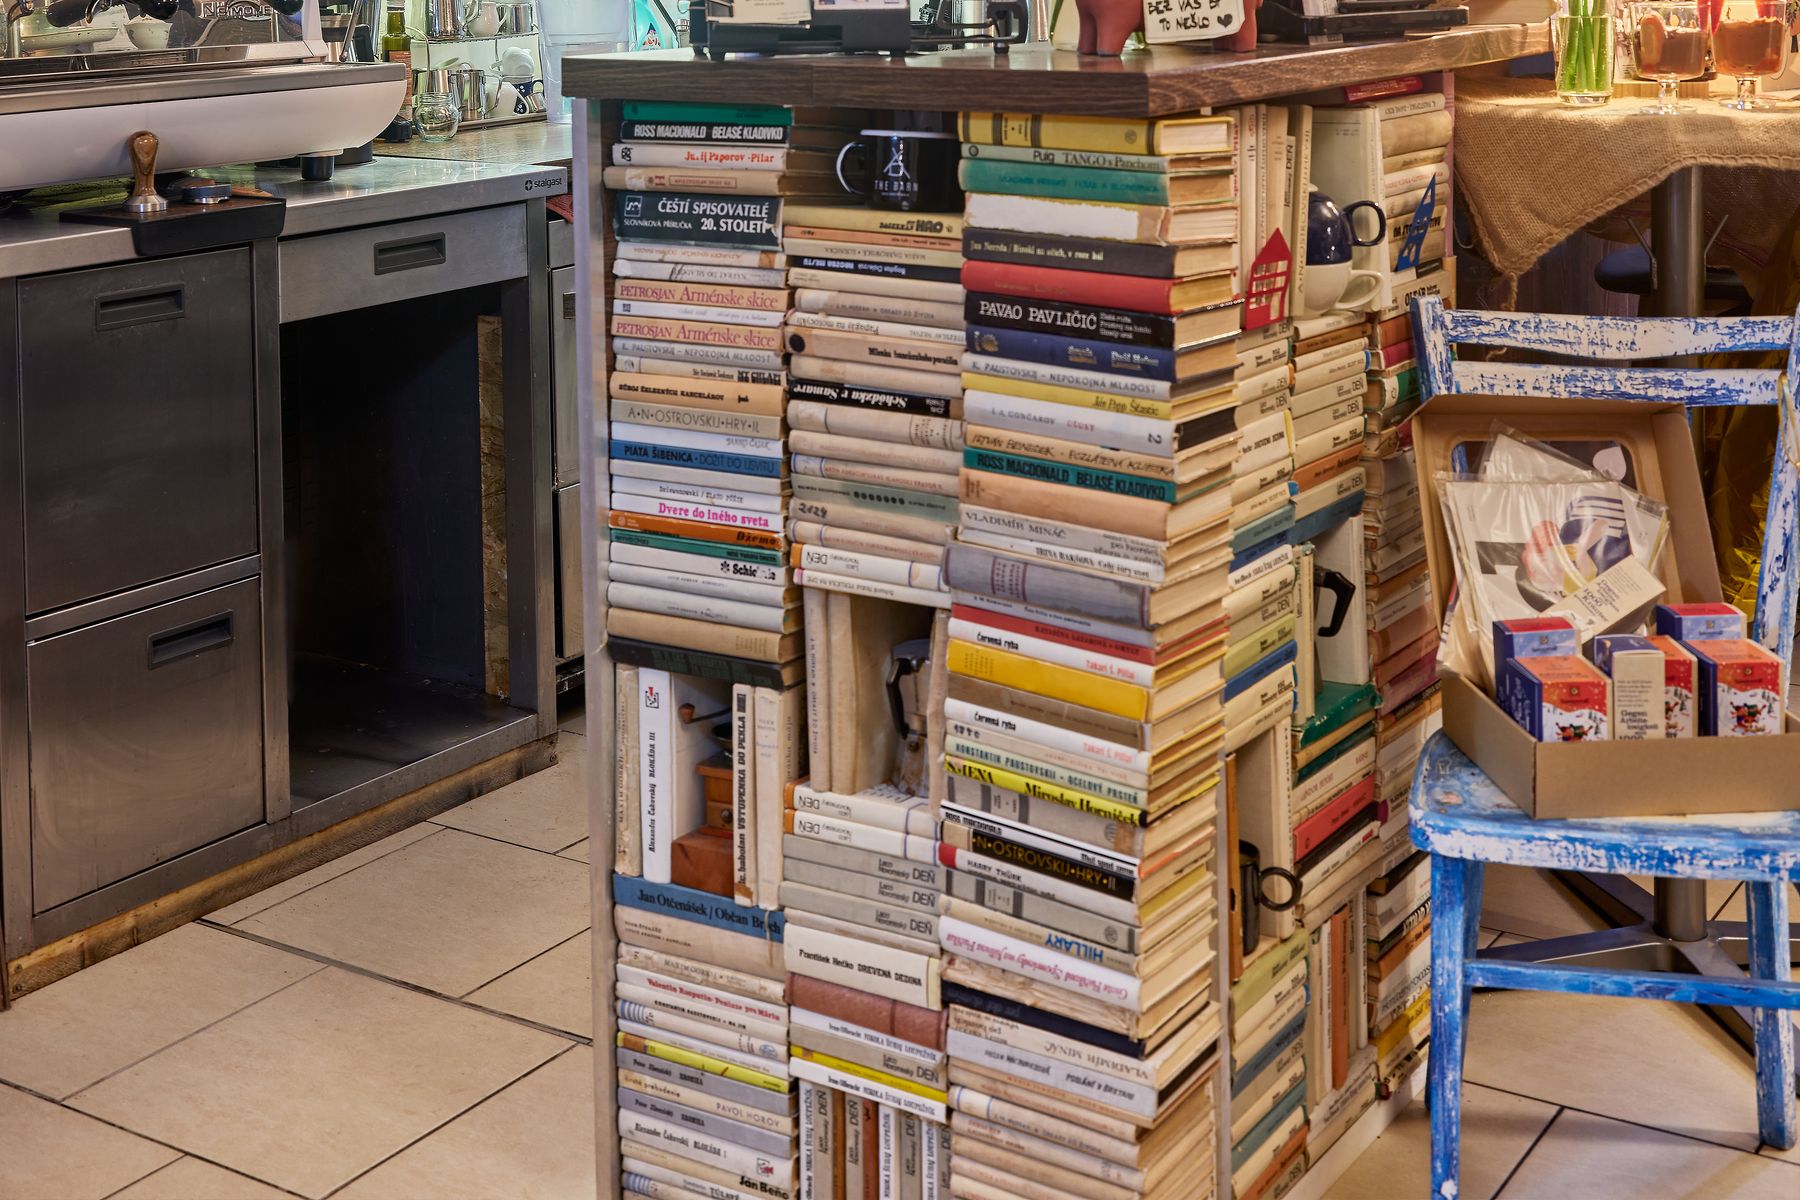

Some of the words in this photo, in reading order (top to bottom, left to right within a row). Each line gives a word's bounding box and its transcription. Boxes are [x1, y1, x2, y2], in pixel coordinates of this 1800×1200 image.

[1147, 0, 1173, 15] BEZ
[1159, 17, 1171, 32] TO
[1176, 11, 1211, 30] NEŠLO
[634, 124, 656, 137] ROSS
[656, 125, 707, 139] MACDONALD
[711, 125, 742, 139] BELASÉ
[743, 126, 783, 140] KLADIVKO
[1062, 152, 1106, 167] TANGO
[534, 176, 562, 190] stalgast
[874, 180, 889, 191] THE
[893, 180, 918, 192] BARN
[658, 197, 690, 214] ČEŠTÍ
[692, 201, 770, 218] SPISOVATELÉ
[700, 218, 717, 231] 20.
[719, 217, 768, 234] STOLETÍ
[620, 284, 676, 300] PETROSJAN
[680, 285, 744, 305] Arménske
[746, 292, 778, 309] skice
[979, 301, 1023, 320] PAVAO
[616, 322, 673, 337] PETROSJAN
[676, 324, 741, 344] Arménske
[743, 331, 775, 347] skice
[1050, 373, 1107, 389] NEPOKOJNÁ
[624, 445, 650, 457] PIATA
[652, 446, 694, 463] ŠIBENICA
[977, 453, 1004, 468] ROSS
[1006, 458, 1070, 483] MACDONALD
[1076, 471, 1114, 492] BELASÉ
[1116, 479, 1166, 501] KLADIVKO
[658, 502, 690, 517] Dvere
[692, 507, 705, 519] do
[707, 508, 738, 523] iného
[741, 514, 769, 528] sveta
[737, 746, 747, 766] DO
[955, 743, 1001, 764] KONSTANTIN
[737, 768, 747, 830] VSTUPENKA
[1025, 781, 1077, 810] Miroslav
[1079, 798, 1138, 827] Horníček
[967, 859, 993, 872] HARRY
[638, 889, 655, 904] Jan
[656, 894, 709, 917] Otčenášek
[715, 908, 749, 926] Občan
[1045, 933, 1104, 963] HILLARY
[716, 1102, 744, 1117] PAVOL
[746, 1112, 780, 1128] HOROV
